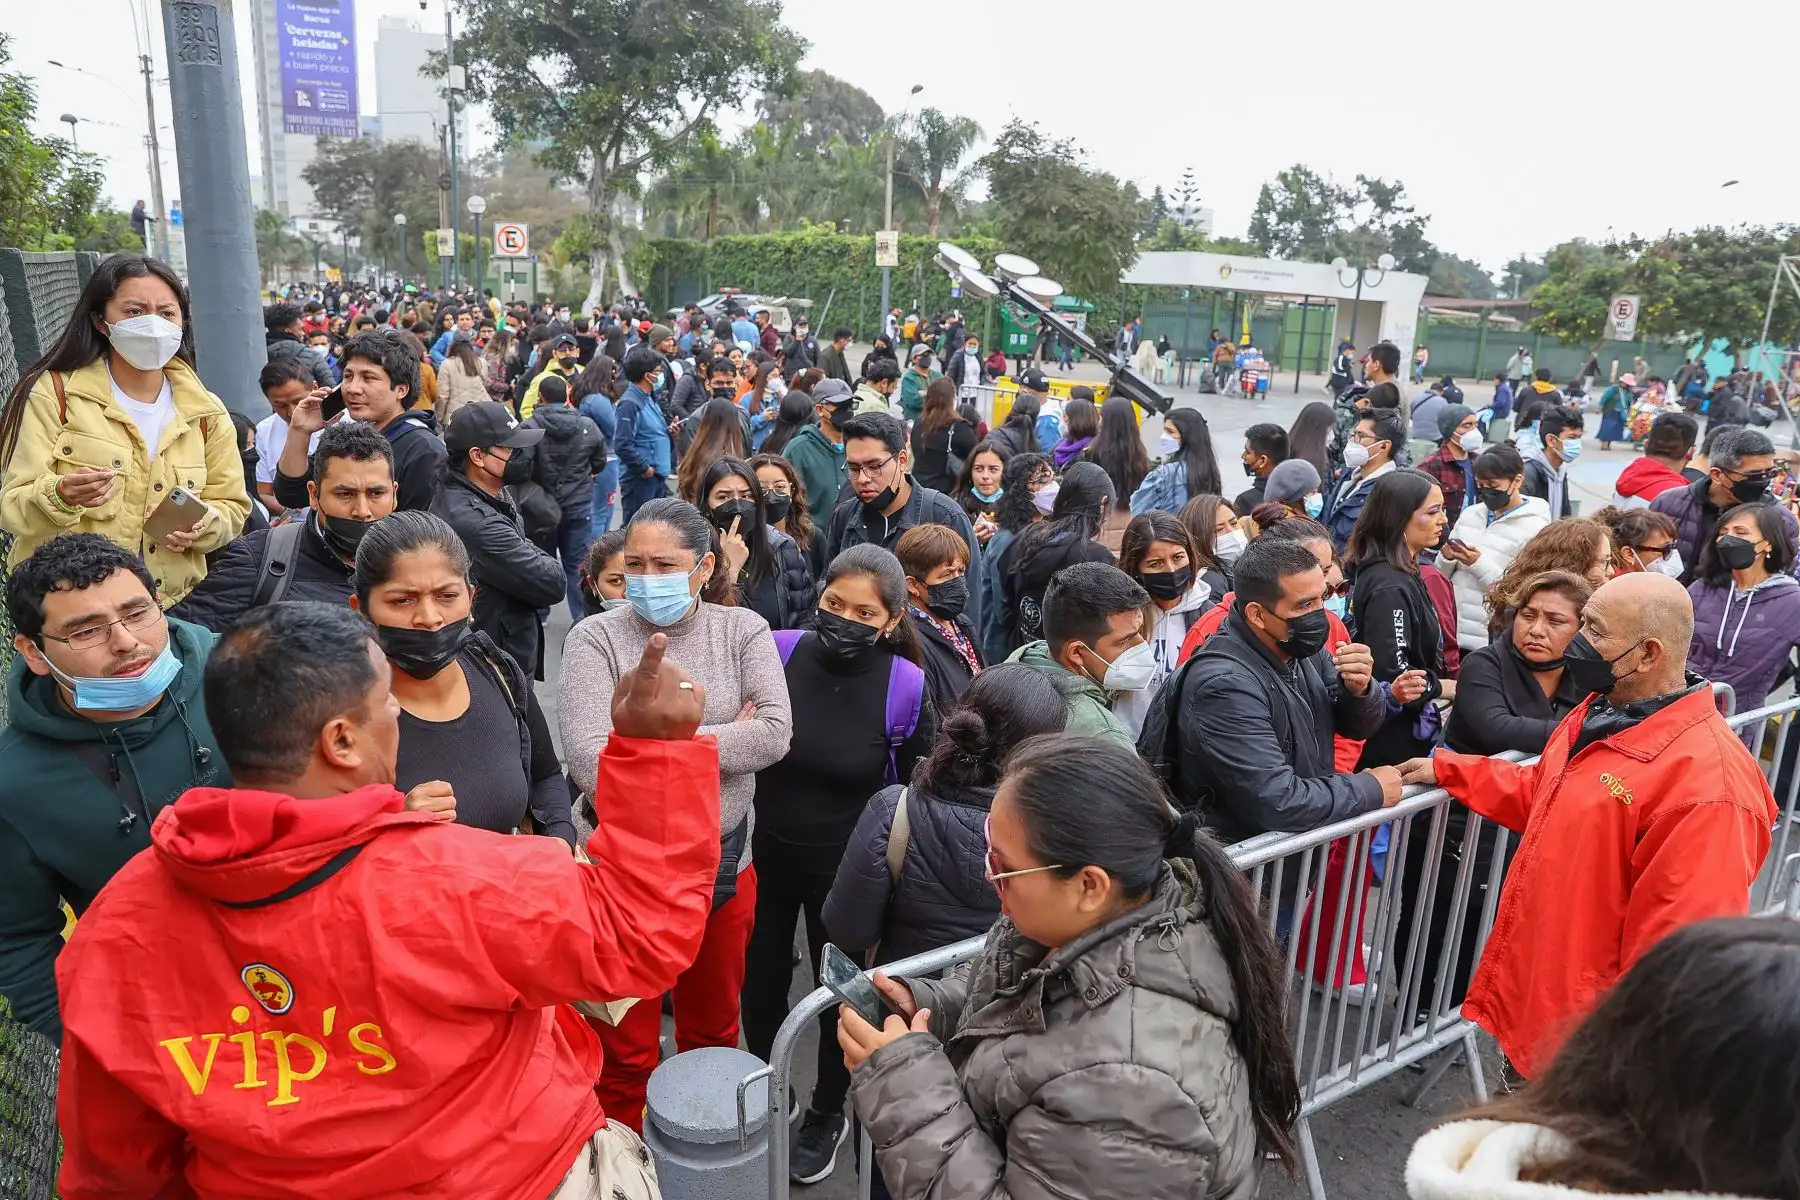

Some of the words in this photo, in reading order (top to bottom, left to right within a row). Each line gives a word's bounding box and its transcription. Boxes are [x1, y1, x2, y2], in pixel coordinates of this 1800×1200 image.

[286, 24, 342, 40] Cervezas
[292, 37, 338, 50] heladas
[293, 60, 318, 71] buen
[320, 64, 350, 74] precio
[160, 1005, 397, 1107] vip's
